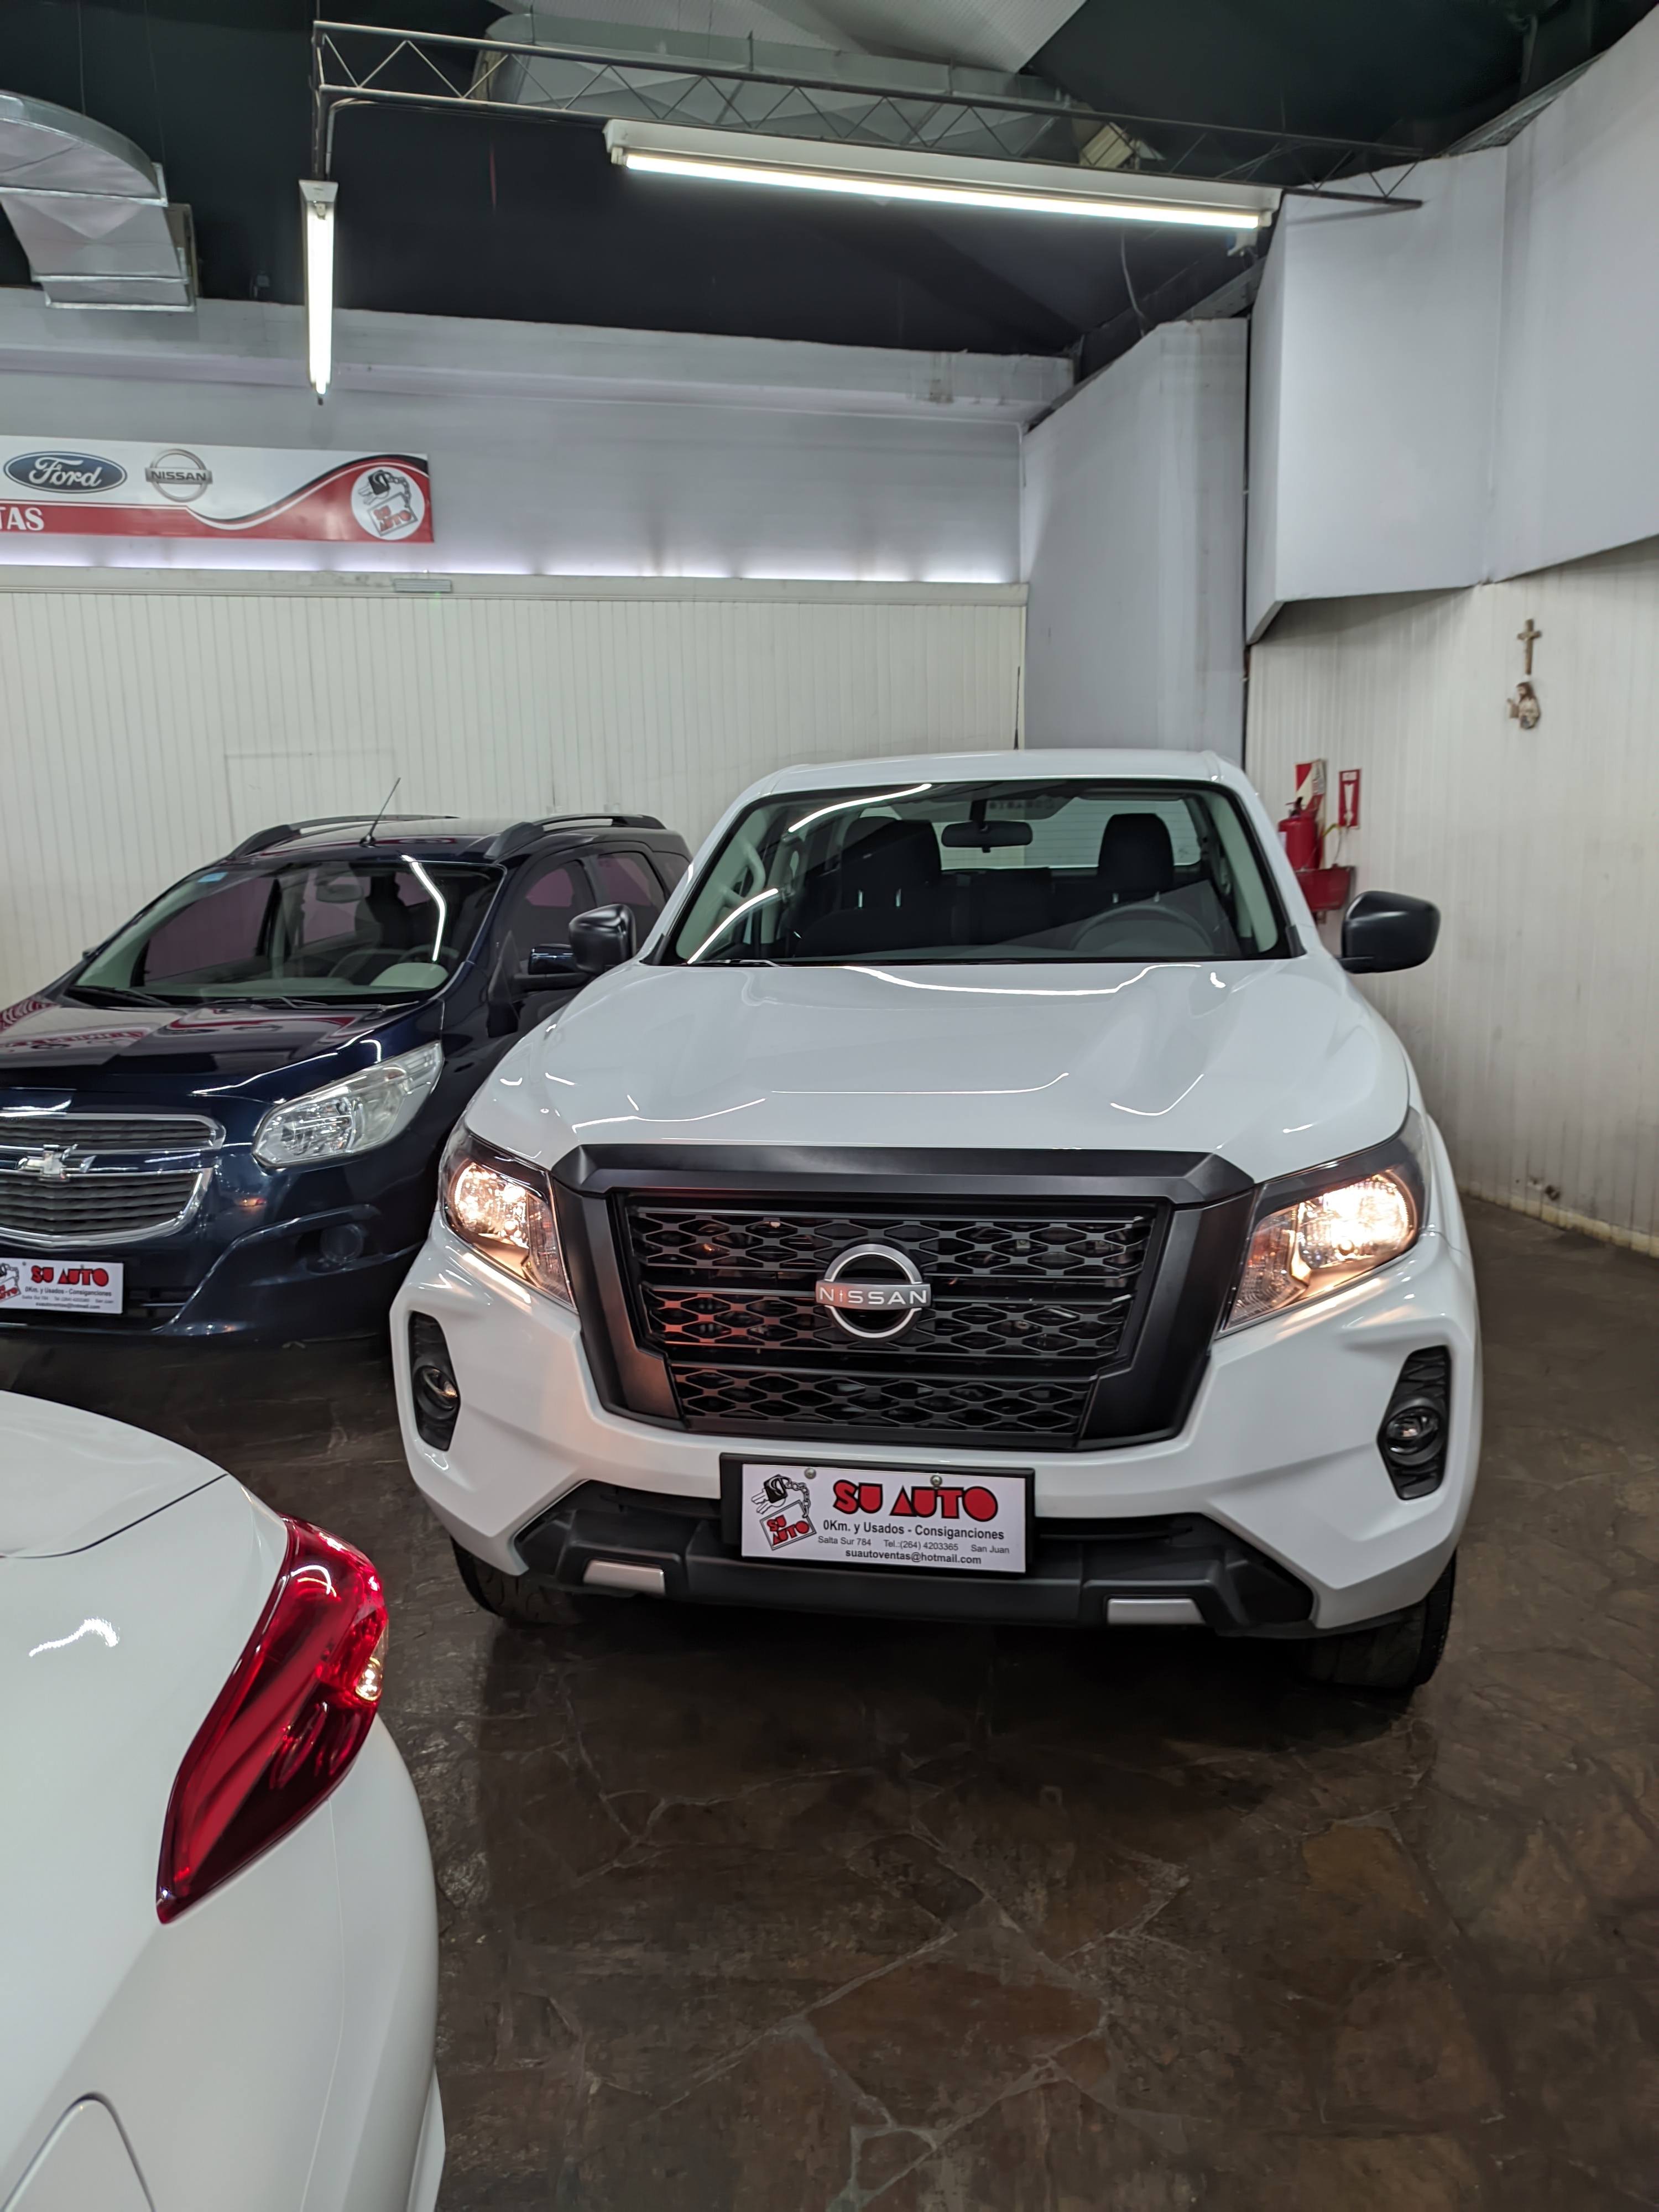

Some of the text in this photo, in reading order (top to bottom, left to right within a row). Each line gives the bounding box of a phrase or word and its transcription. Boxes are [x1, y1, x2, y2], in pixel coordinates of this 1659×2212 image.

[29, 457, 102, 487] Ford
[151, 471, 206, 481] NISSAN
[31, 1265, 109, 1287] SU AUTO
[819, 1287, 927, 1305] NISSAN
[832, 1479, 998, 1522] SU AUTO
[766, 1515, 786, 1532] SU
[773, 1520, 810, 1545] AUTO
[823, 1520, 851, 1532] 0Km.
[854, 1524, 860, 1534] y
[863, 1522, 905, 1534] Usados
[915, 1525, 1004, 1540] Consiganciones
[818, 1536, 838, 1545] Salta
[923, 1542, 958, 1551] 4203365
[971, 1544, 987, 1553] San
[990, 1545, 1009, 1554] Juan
[846, 1549, 982, 1564] suautoventas@hotmail.com
